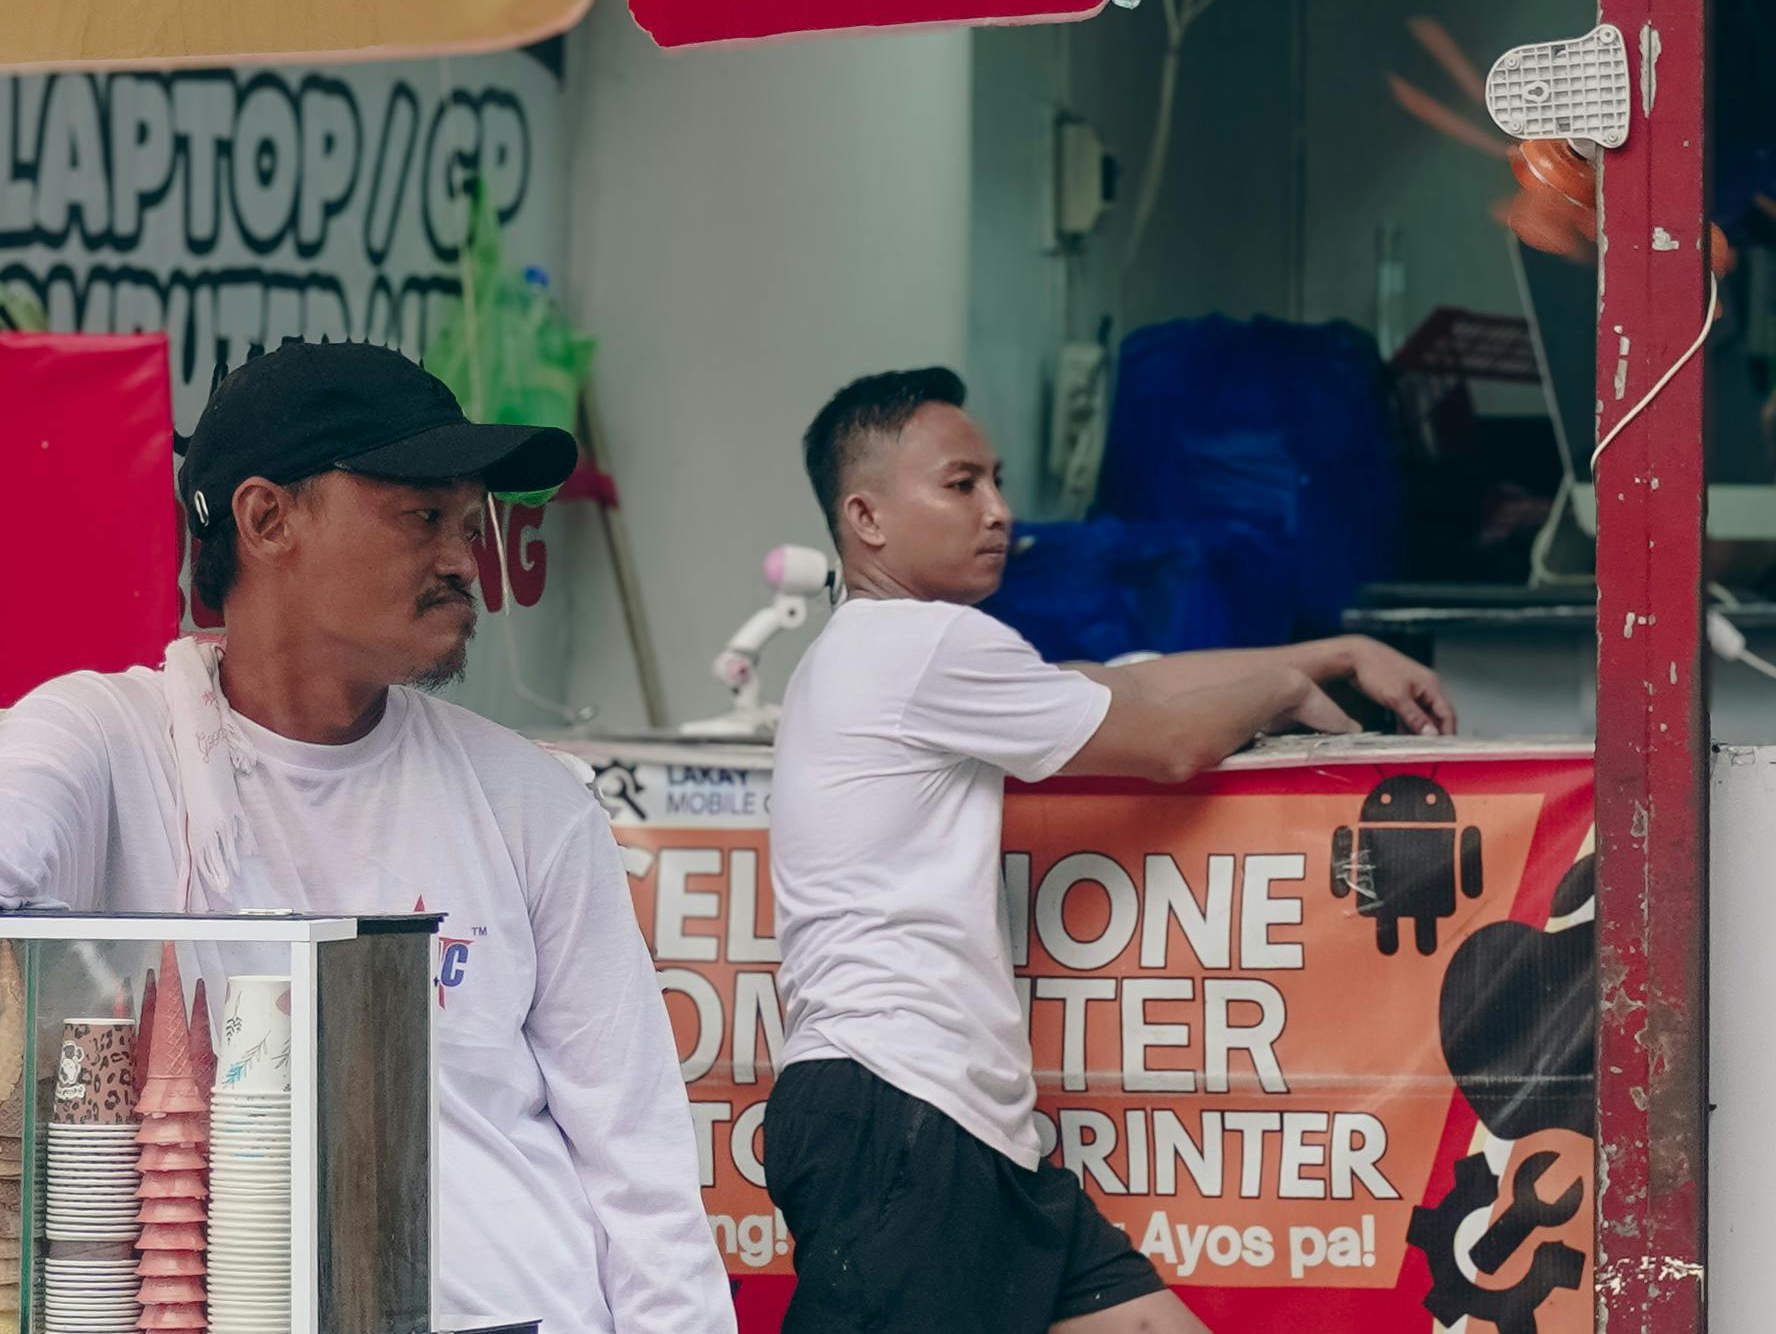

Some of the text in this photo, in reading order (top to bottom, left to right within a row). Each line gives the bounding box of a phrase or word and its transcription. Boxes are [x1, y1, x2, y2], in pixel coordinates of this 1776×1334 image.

[667, 792, 756, 815] MOBILE
[1140, 1211, 1275, 1277] Ayos
[1288, 1214, 1377, 1280] pa!
